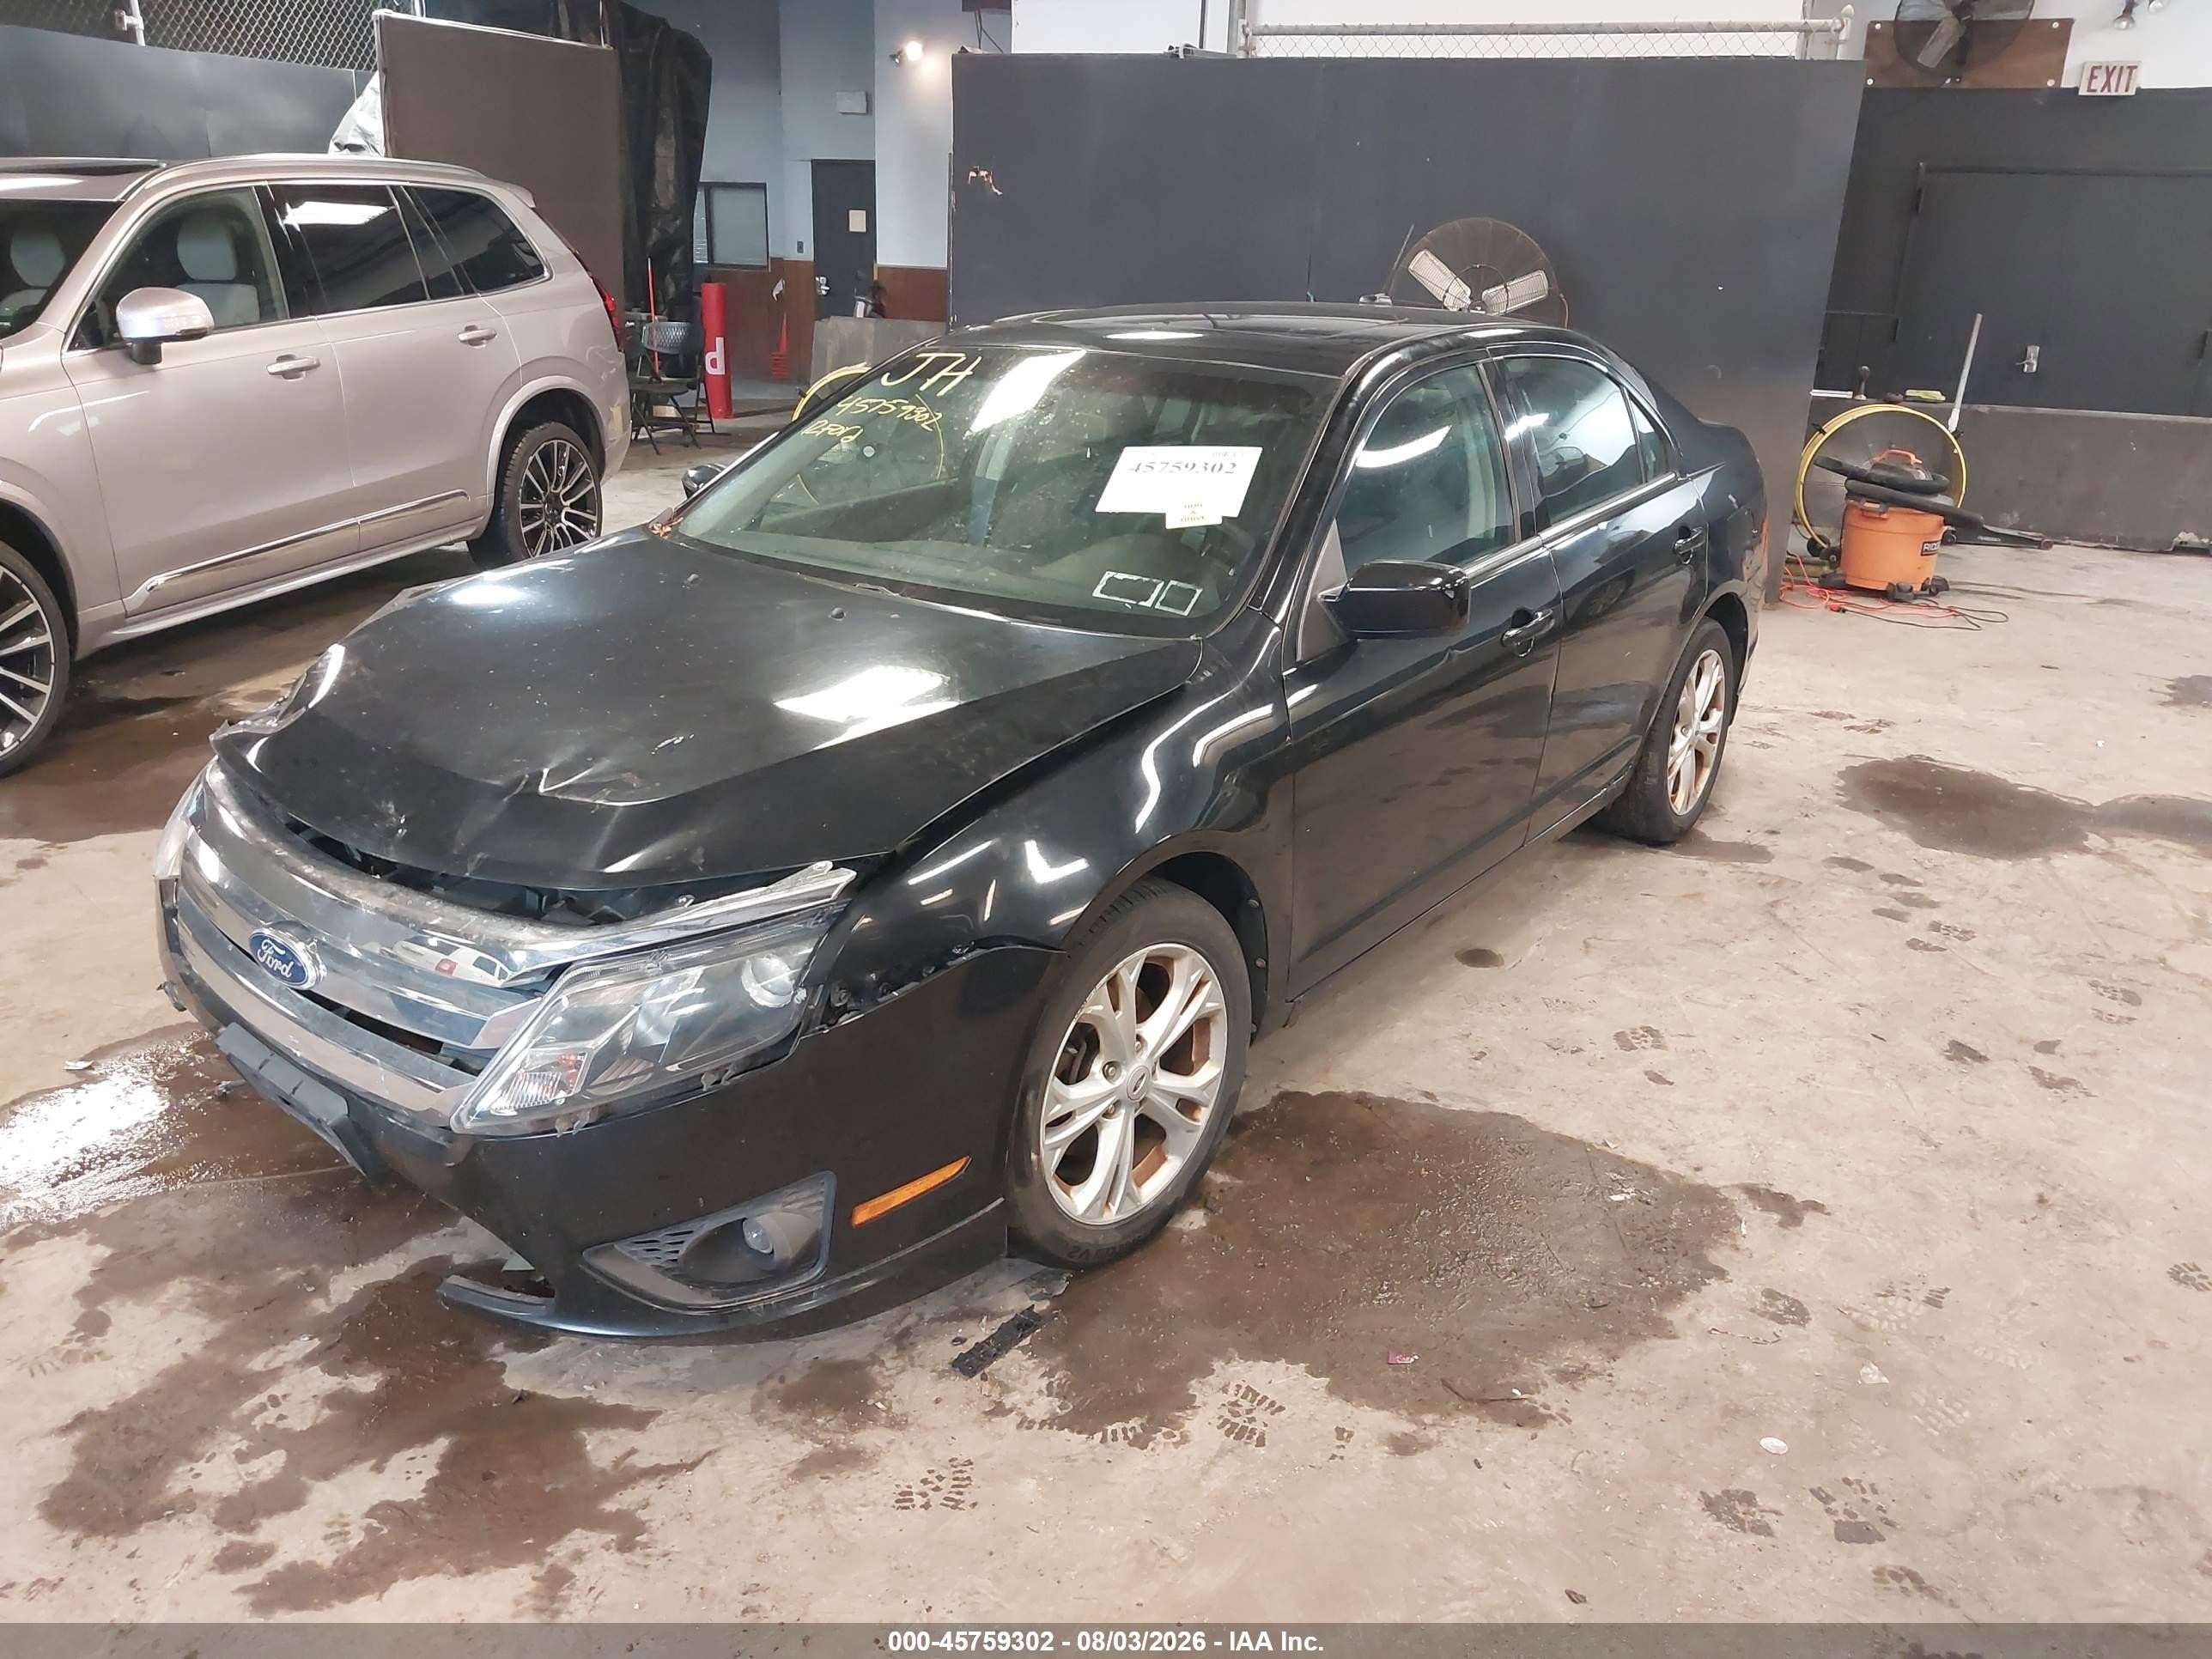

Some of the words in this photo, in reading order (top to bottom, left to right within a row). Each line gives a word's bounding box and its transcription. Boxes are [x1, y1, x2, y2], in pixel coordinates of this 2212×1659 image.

[2087, 65, 2138, 92] EXIT
[881, 353, 981, 397] JH
[836, 395, 943, 431] 45759302
[1128, 461, 1237, 474] 45759302
[258, 939, 295, 978] Ford
